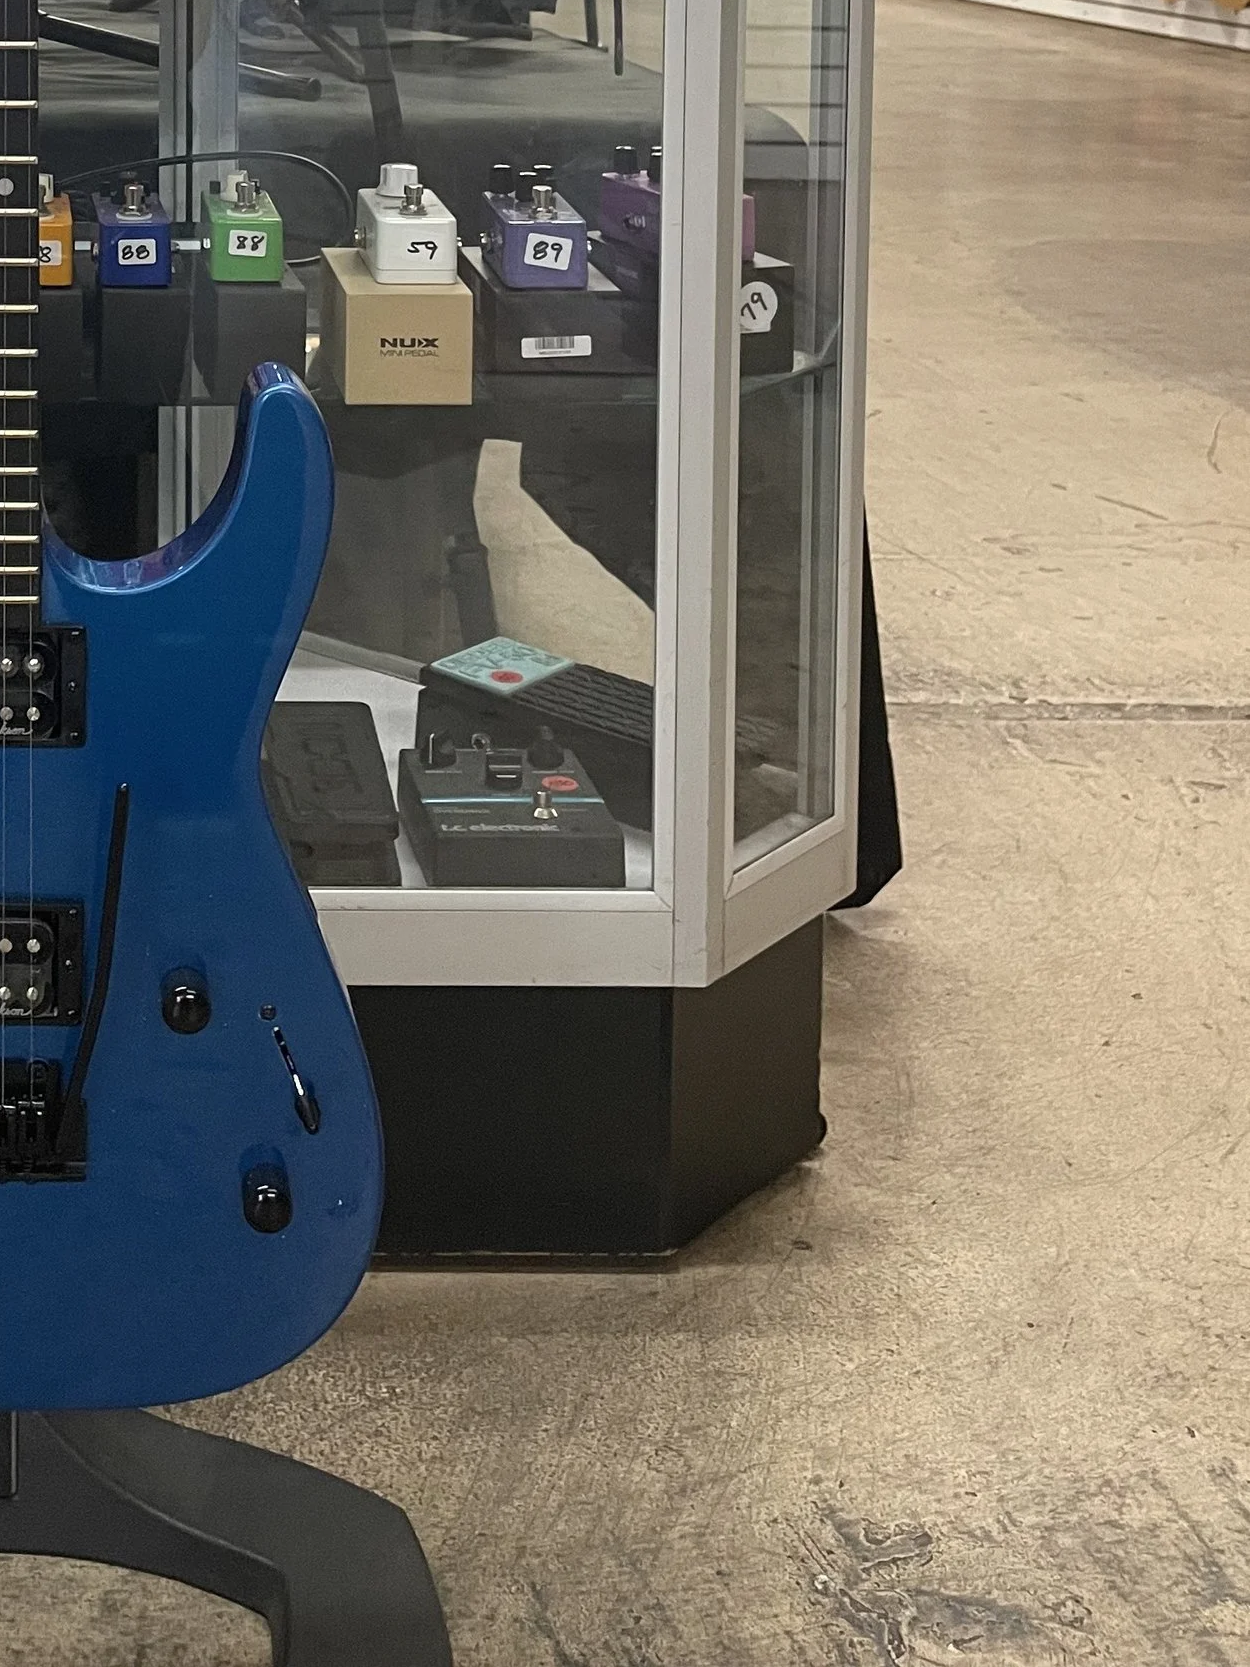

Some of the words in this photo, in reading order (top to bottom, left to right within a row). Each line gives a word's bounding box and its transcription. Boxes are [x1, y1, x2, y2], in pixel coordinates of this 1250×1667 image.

[235, 235, 265, 251] 88
[407, 240, 438, 260] 59
[121, 244, 150, 260] 88
[532, 240, 563, 263] 89
[740, 292, 768, 320] 79
[380, 337, 439, 348] NUX
[380, 349, 403, 357] MINI
[404, 349, 439, 357] PEDAL
[469, 822, 561, 832] electronic
